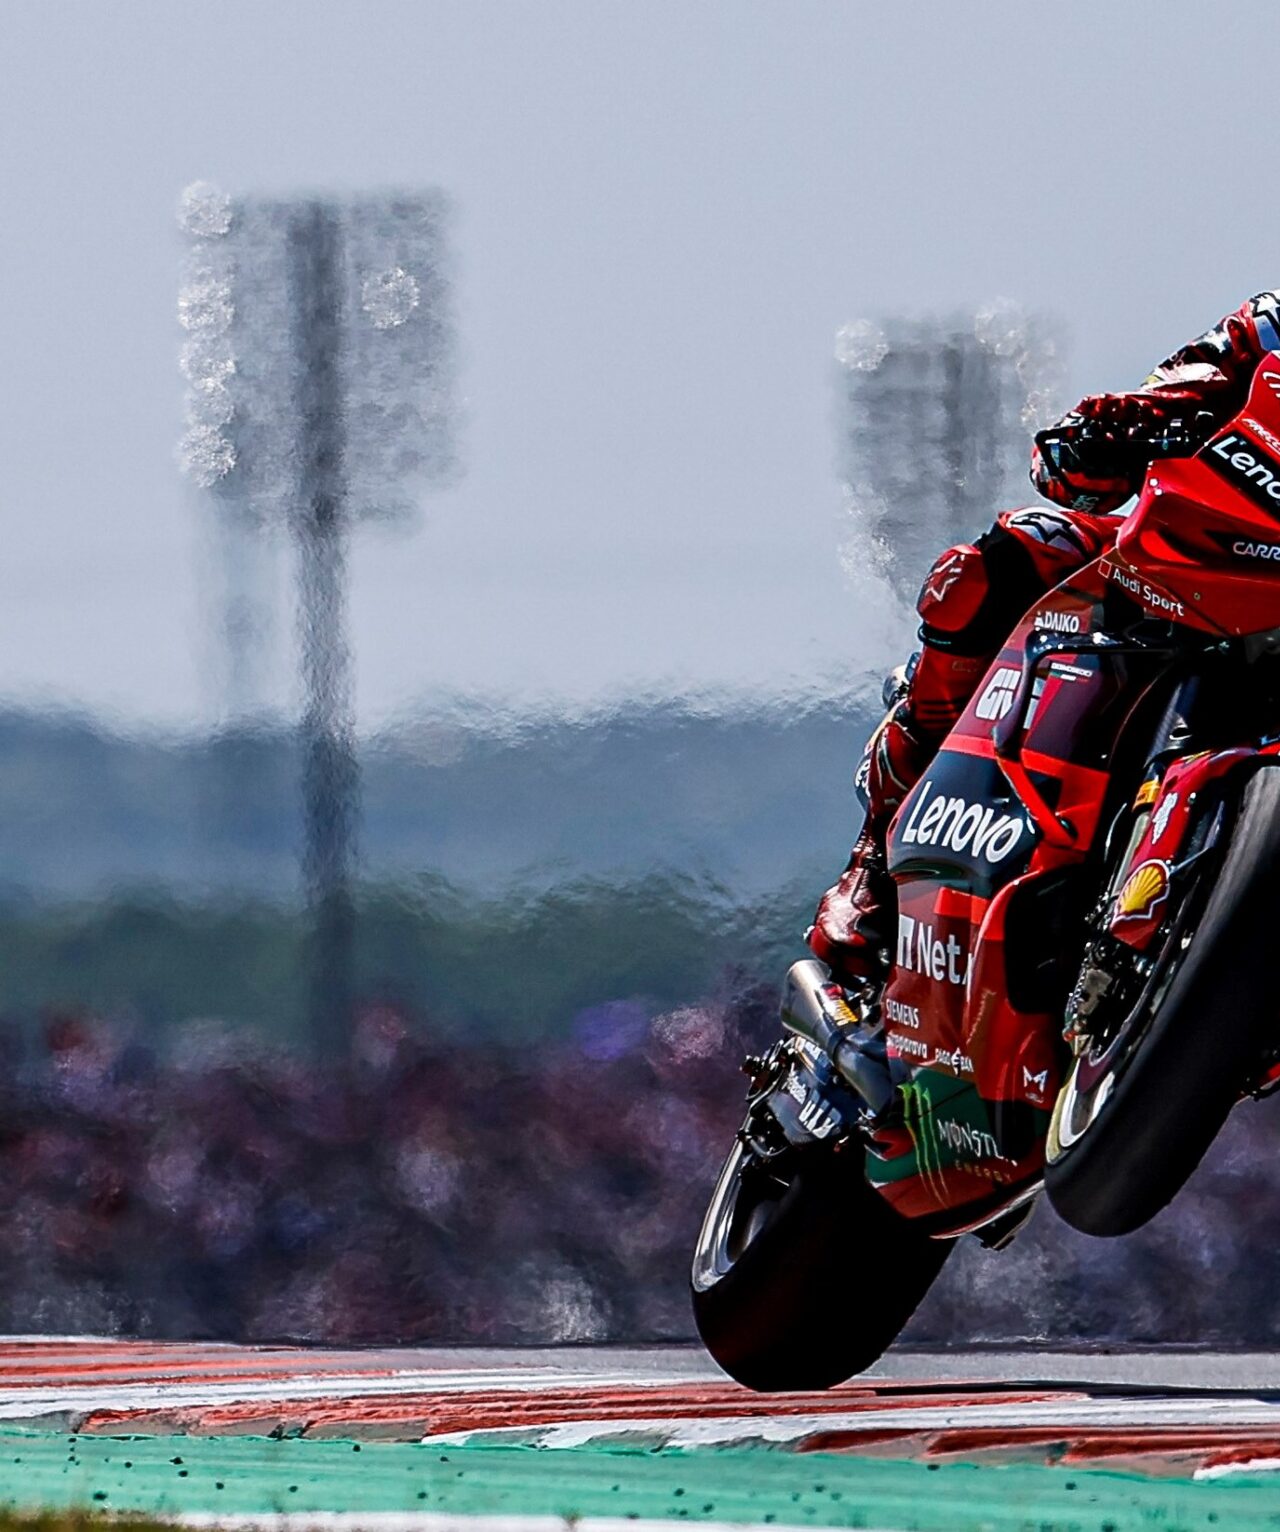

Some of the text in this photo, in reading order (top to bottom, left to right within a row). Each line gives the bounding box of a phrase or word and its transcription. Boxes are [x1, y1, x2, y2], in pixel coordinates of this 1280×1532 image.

[1112, 567, 1185, 617] Audi Sport
[901, 780, 1024, 864] Lenovo
